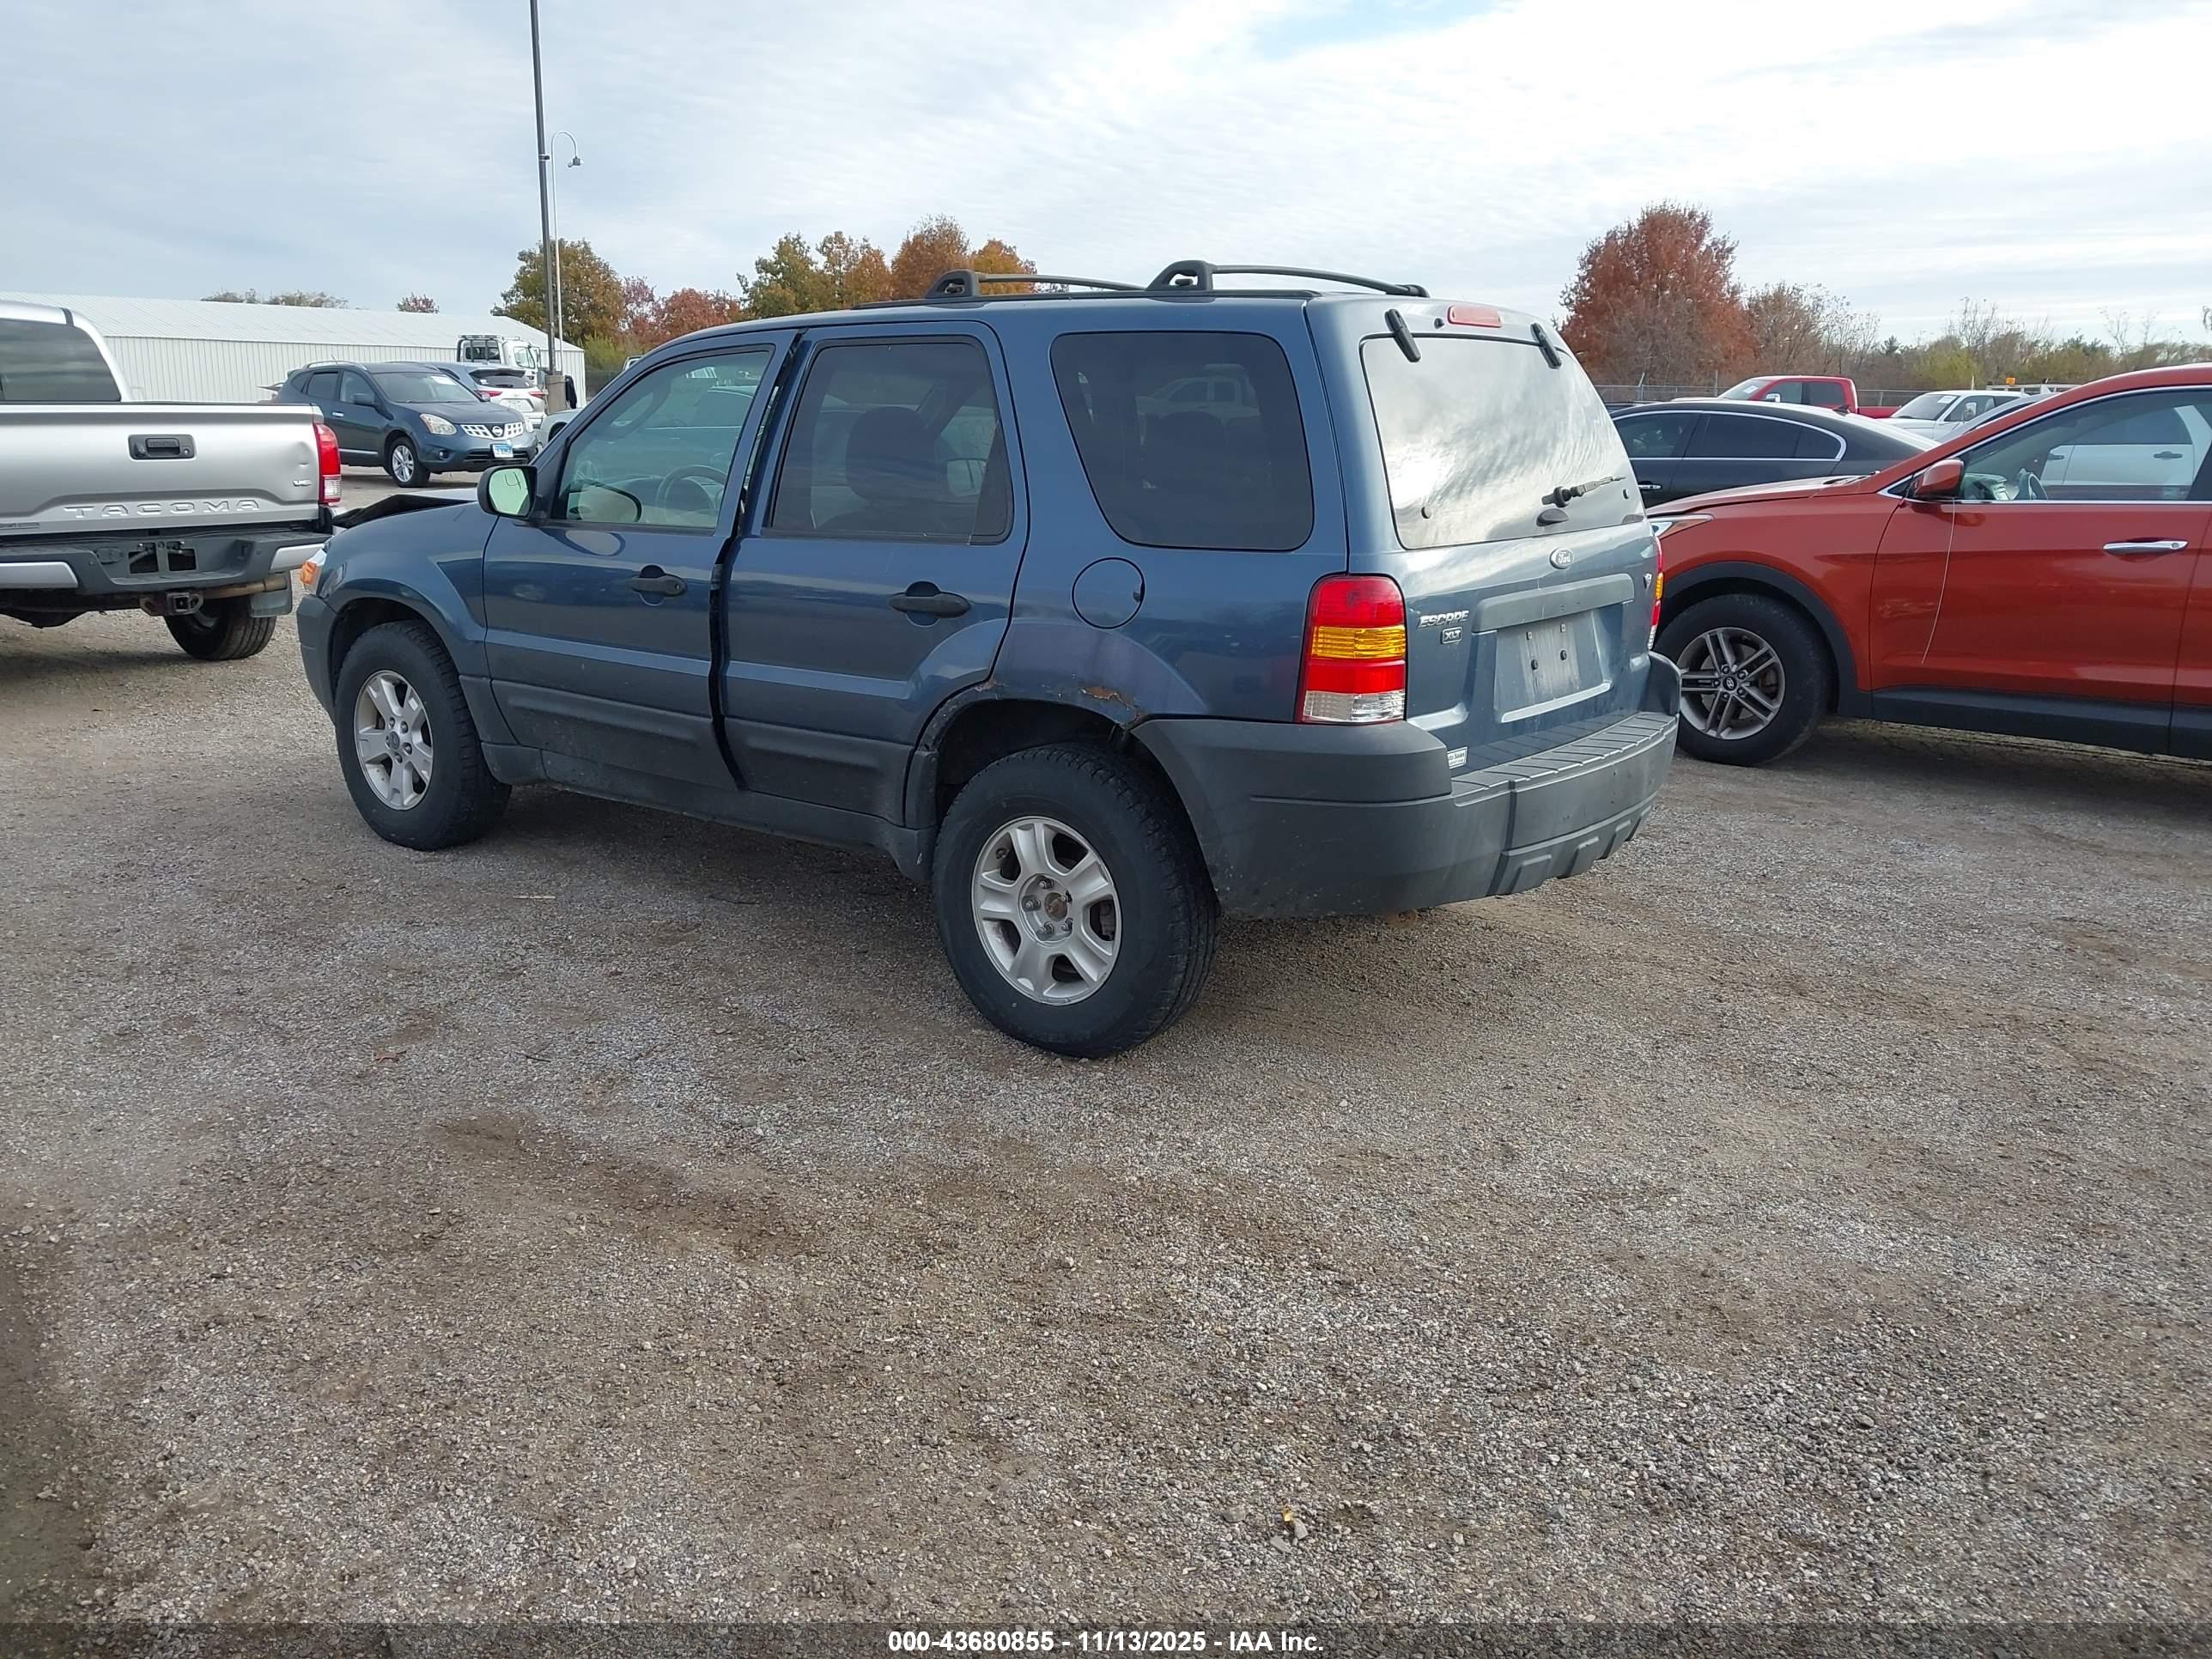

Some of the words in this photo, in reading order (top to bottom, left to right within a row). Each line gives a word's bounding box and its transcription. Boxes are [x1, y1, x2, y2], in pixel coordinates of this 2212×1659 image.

[63, 499, 260, 519] TACOMA
[1418, 610, 1469, 629] ESCAPE
[1444, 629, 1462, 641] XLT
